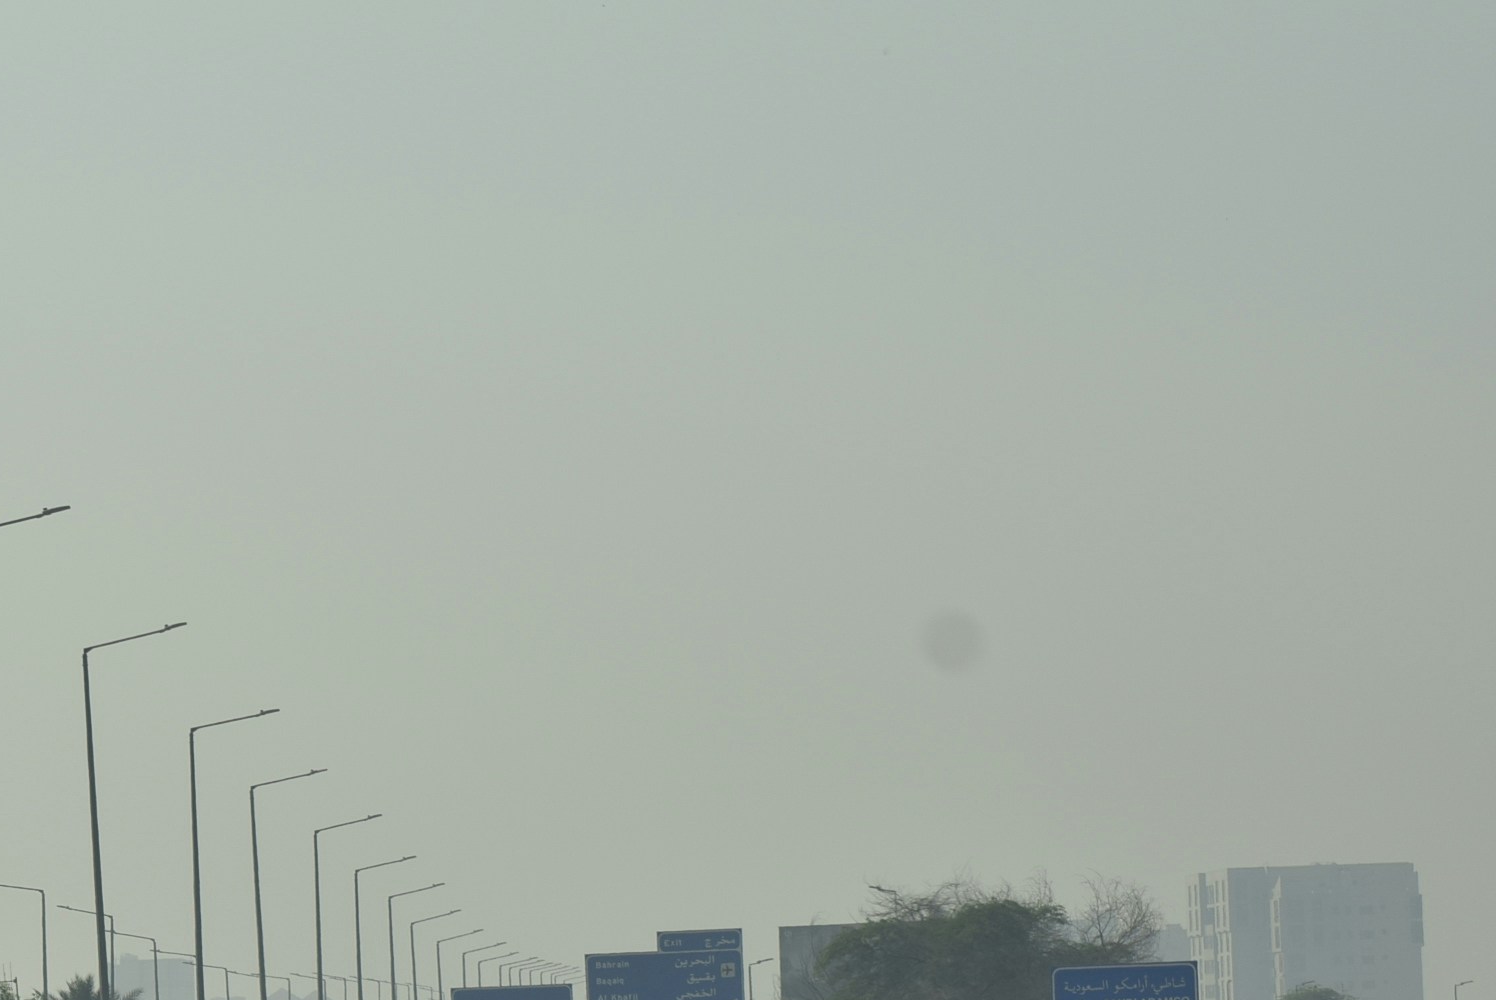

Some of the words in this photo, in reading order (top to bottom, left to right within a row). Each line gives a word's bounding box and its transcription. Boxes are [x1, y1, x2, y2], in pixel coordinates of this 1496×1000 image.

[663, 939, 682, 948] Exit
[704, 935, 736, 948] مخرج
[595, 961, 630, 969] Bahrain
[674, 954, 715, 969] البحرين
[686, 972, 716, 985] بقيق
[1114, 974, 1149, 995] أرامكو
[1063, 979, 1110, 996] السعودية
